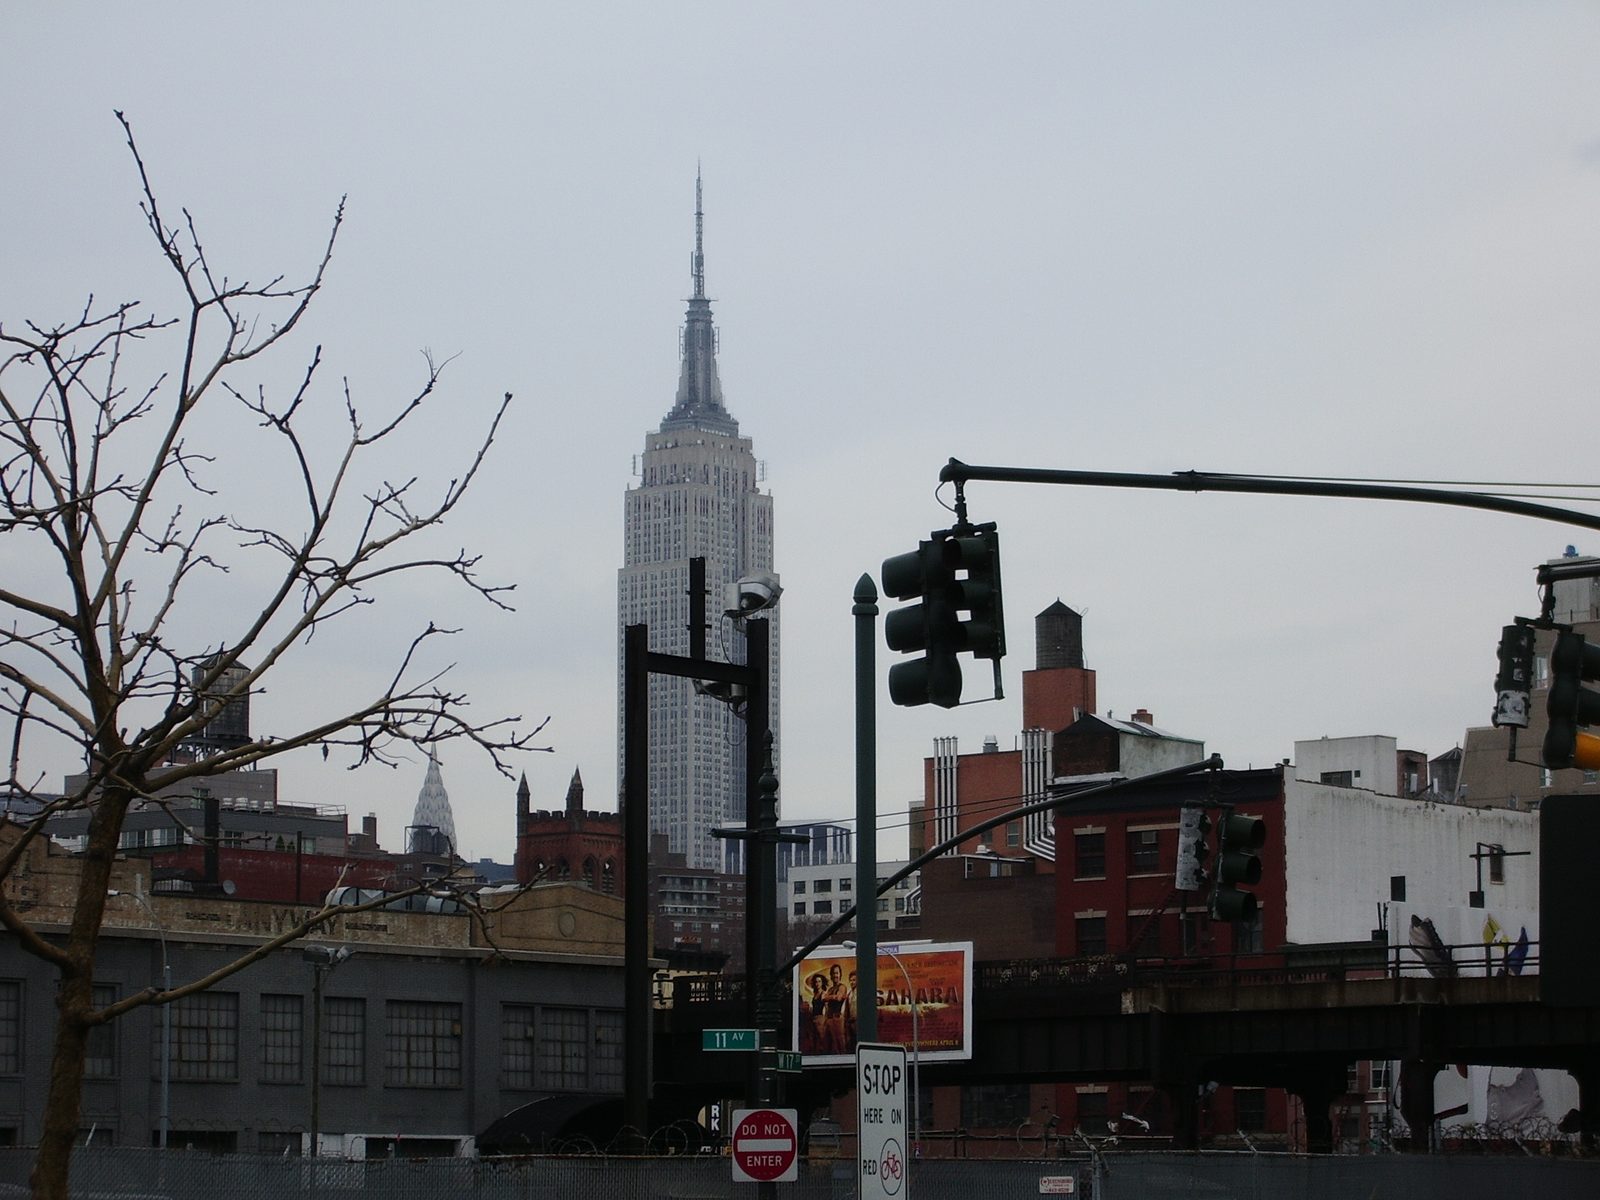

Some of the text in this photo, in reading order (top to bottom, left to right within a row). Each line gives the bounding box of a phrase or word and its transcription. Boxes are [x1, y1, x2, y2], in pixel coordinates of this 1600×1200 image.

[876, 987, 959, 1007] SAHARA
[715, 1032, 745, 1049] 11 AV
[786, 1054, 795, 1070] 17
[864, 1064, 902, 1096] STOP
[863, 1108, 902, 1124] HERE ON
[742, 1123, 787, 1136] DO NOT
[747, 1155, 783, 1168] ENTER
[863, 1159, 878, 1176] RED
